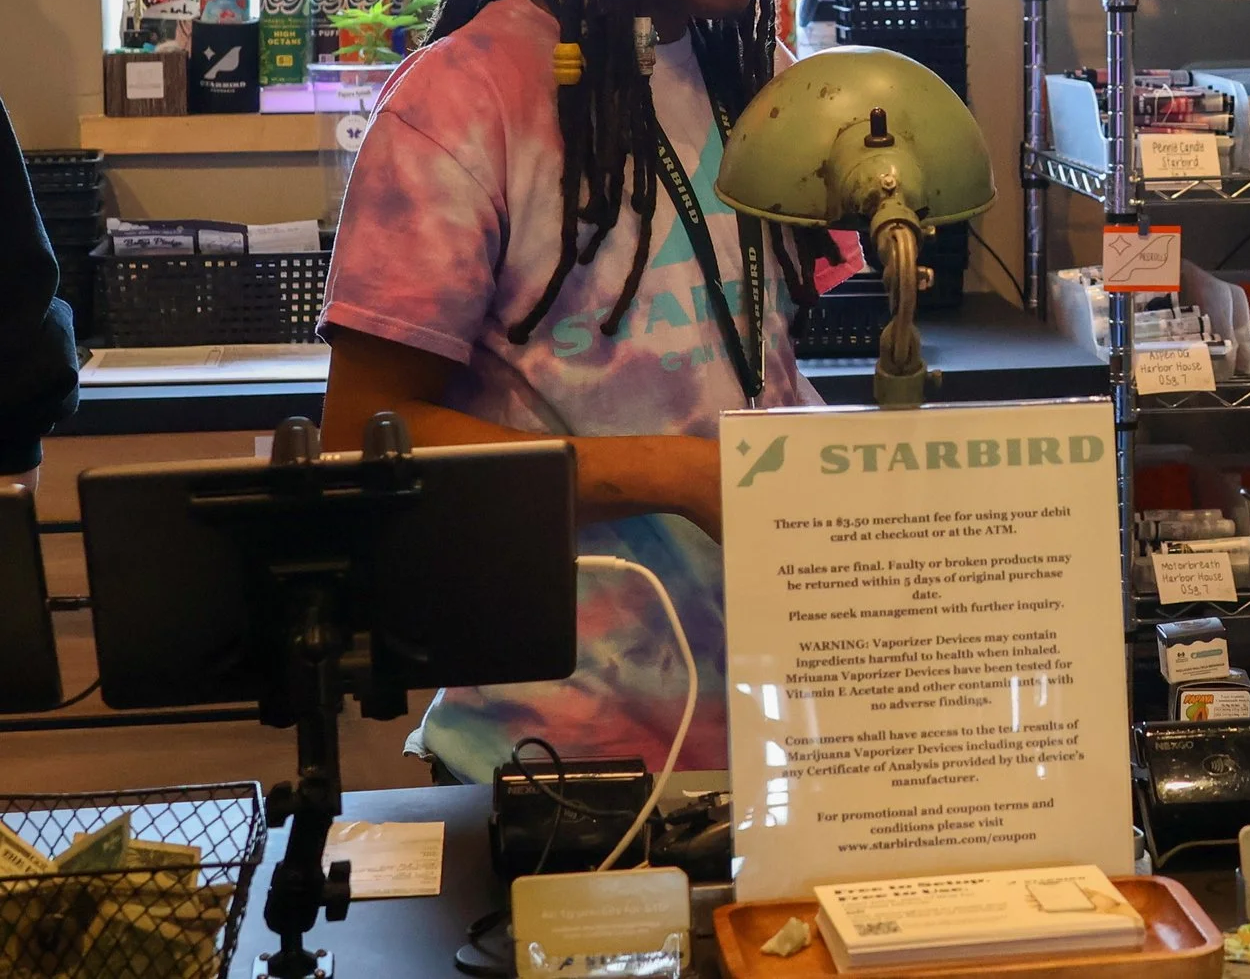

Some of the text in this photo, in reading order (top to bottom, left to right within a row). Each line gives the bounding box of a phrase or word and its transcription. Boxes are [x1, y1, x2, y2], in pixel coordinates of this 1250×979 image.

[273, 30, 296, 38] HIGH
[1162, 156, 1199, 168] Starbird
[656, 142, 700, 225] ARBIRD
[1149, 350, 1174, 361] Aspen
[1141, 362, 1202, 373] Harbor House
[820, 435, 1104, 475] STARBIRD
[774, 505, 1071, 530] There is a $3.50 merchant fee for using your debit
[829, 524, 1017, 542] card at checkout or at the ATM.
[777, 553, 1072, 576] All sales are final. Faulty or broken products may
[1161, 560, 1220, 570] Motorbreath
[787, 568, 1064, 591] be returned within 5 days of original purchase
[1162, 572, 1224, 583] Harbor House
[911, 589, 942, 601] date.
[788, 598, 1065, 622] Please seek management with further inquiry.
[798, 629, 1057, 652] WARNING: Vaporizer Devices may contain
[796, 644, 1061, 669] ingredients harmful to health when inhaled.
[817, 797, 1055, 824] For promotional and coupon terms and
[869, 816, 1004, 835] conditions please visit
[837, 832, 1037, 853] www.starbirdsalem.com/coupon
